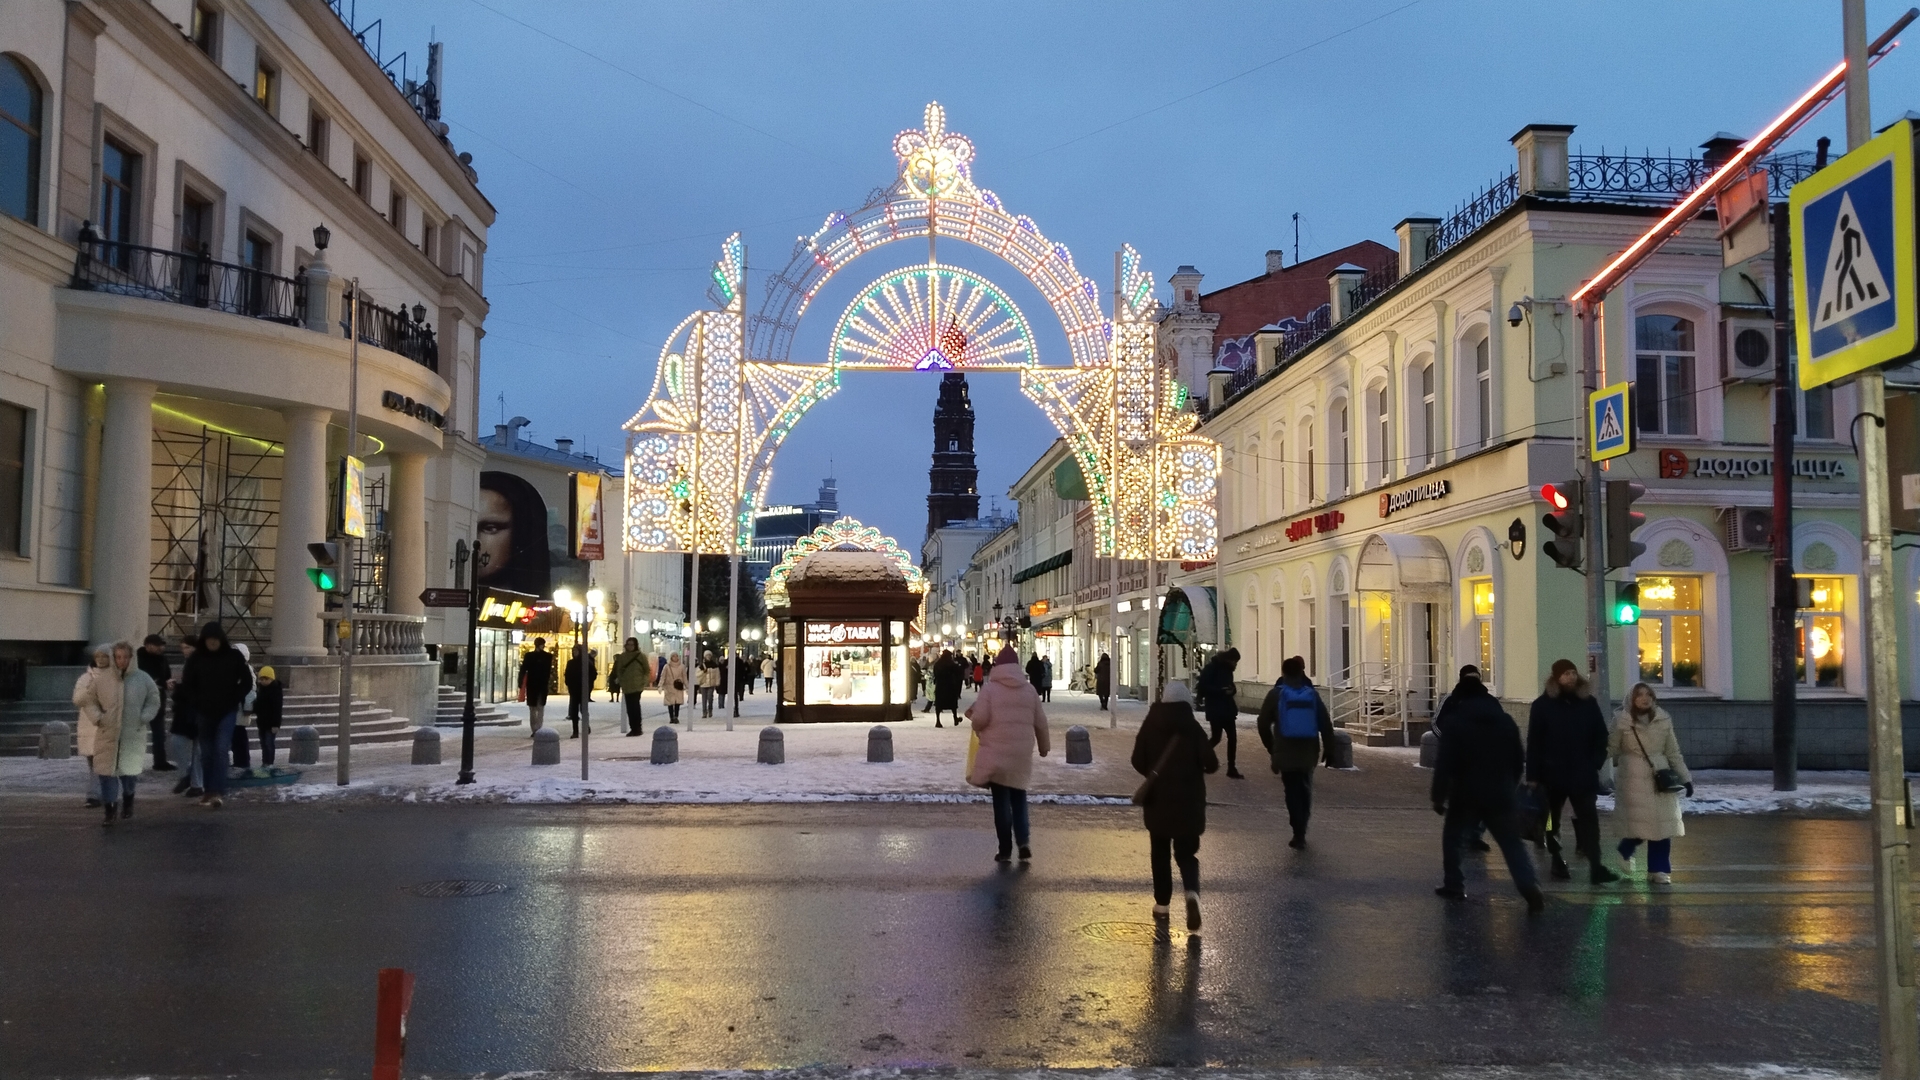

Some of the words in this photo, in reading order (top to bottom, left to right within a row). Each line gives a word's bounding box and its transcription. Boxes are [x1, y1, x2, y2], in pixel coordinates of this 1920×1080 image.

[808, 624, 831, 632] VAPE
[808, 633, 832, 641] SHOP
[846, 627, 879, 639] ТАБАК
